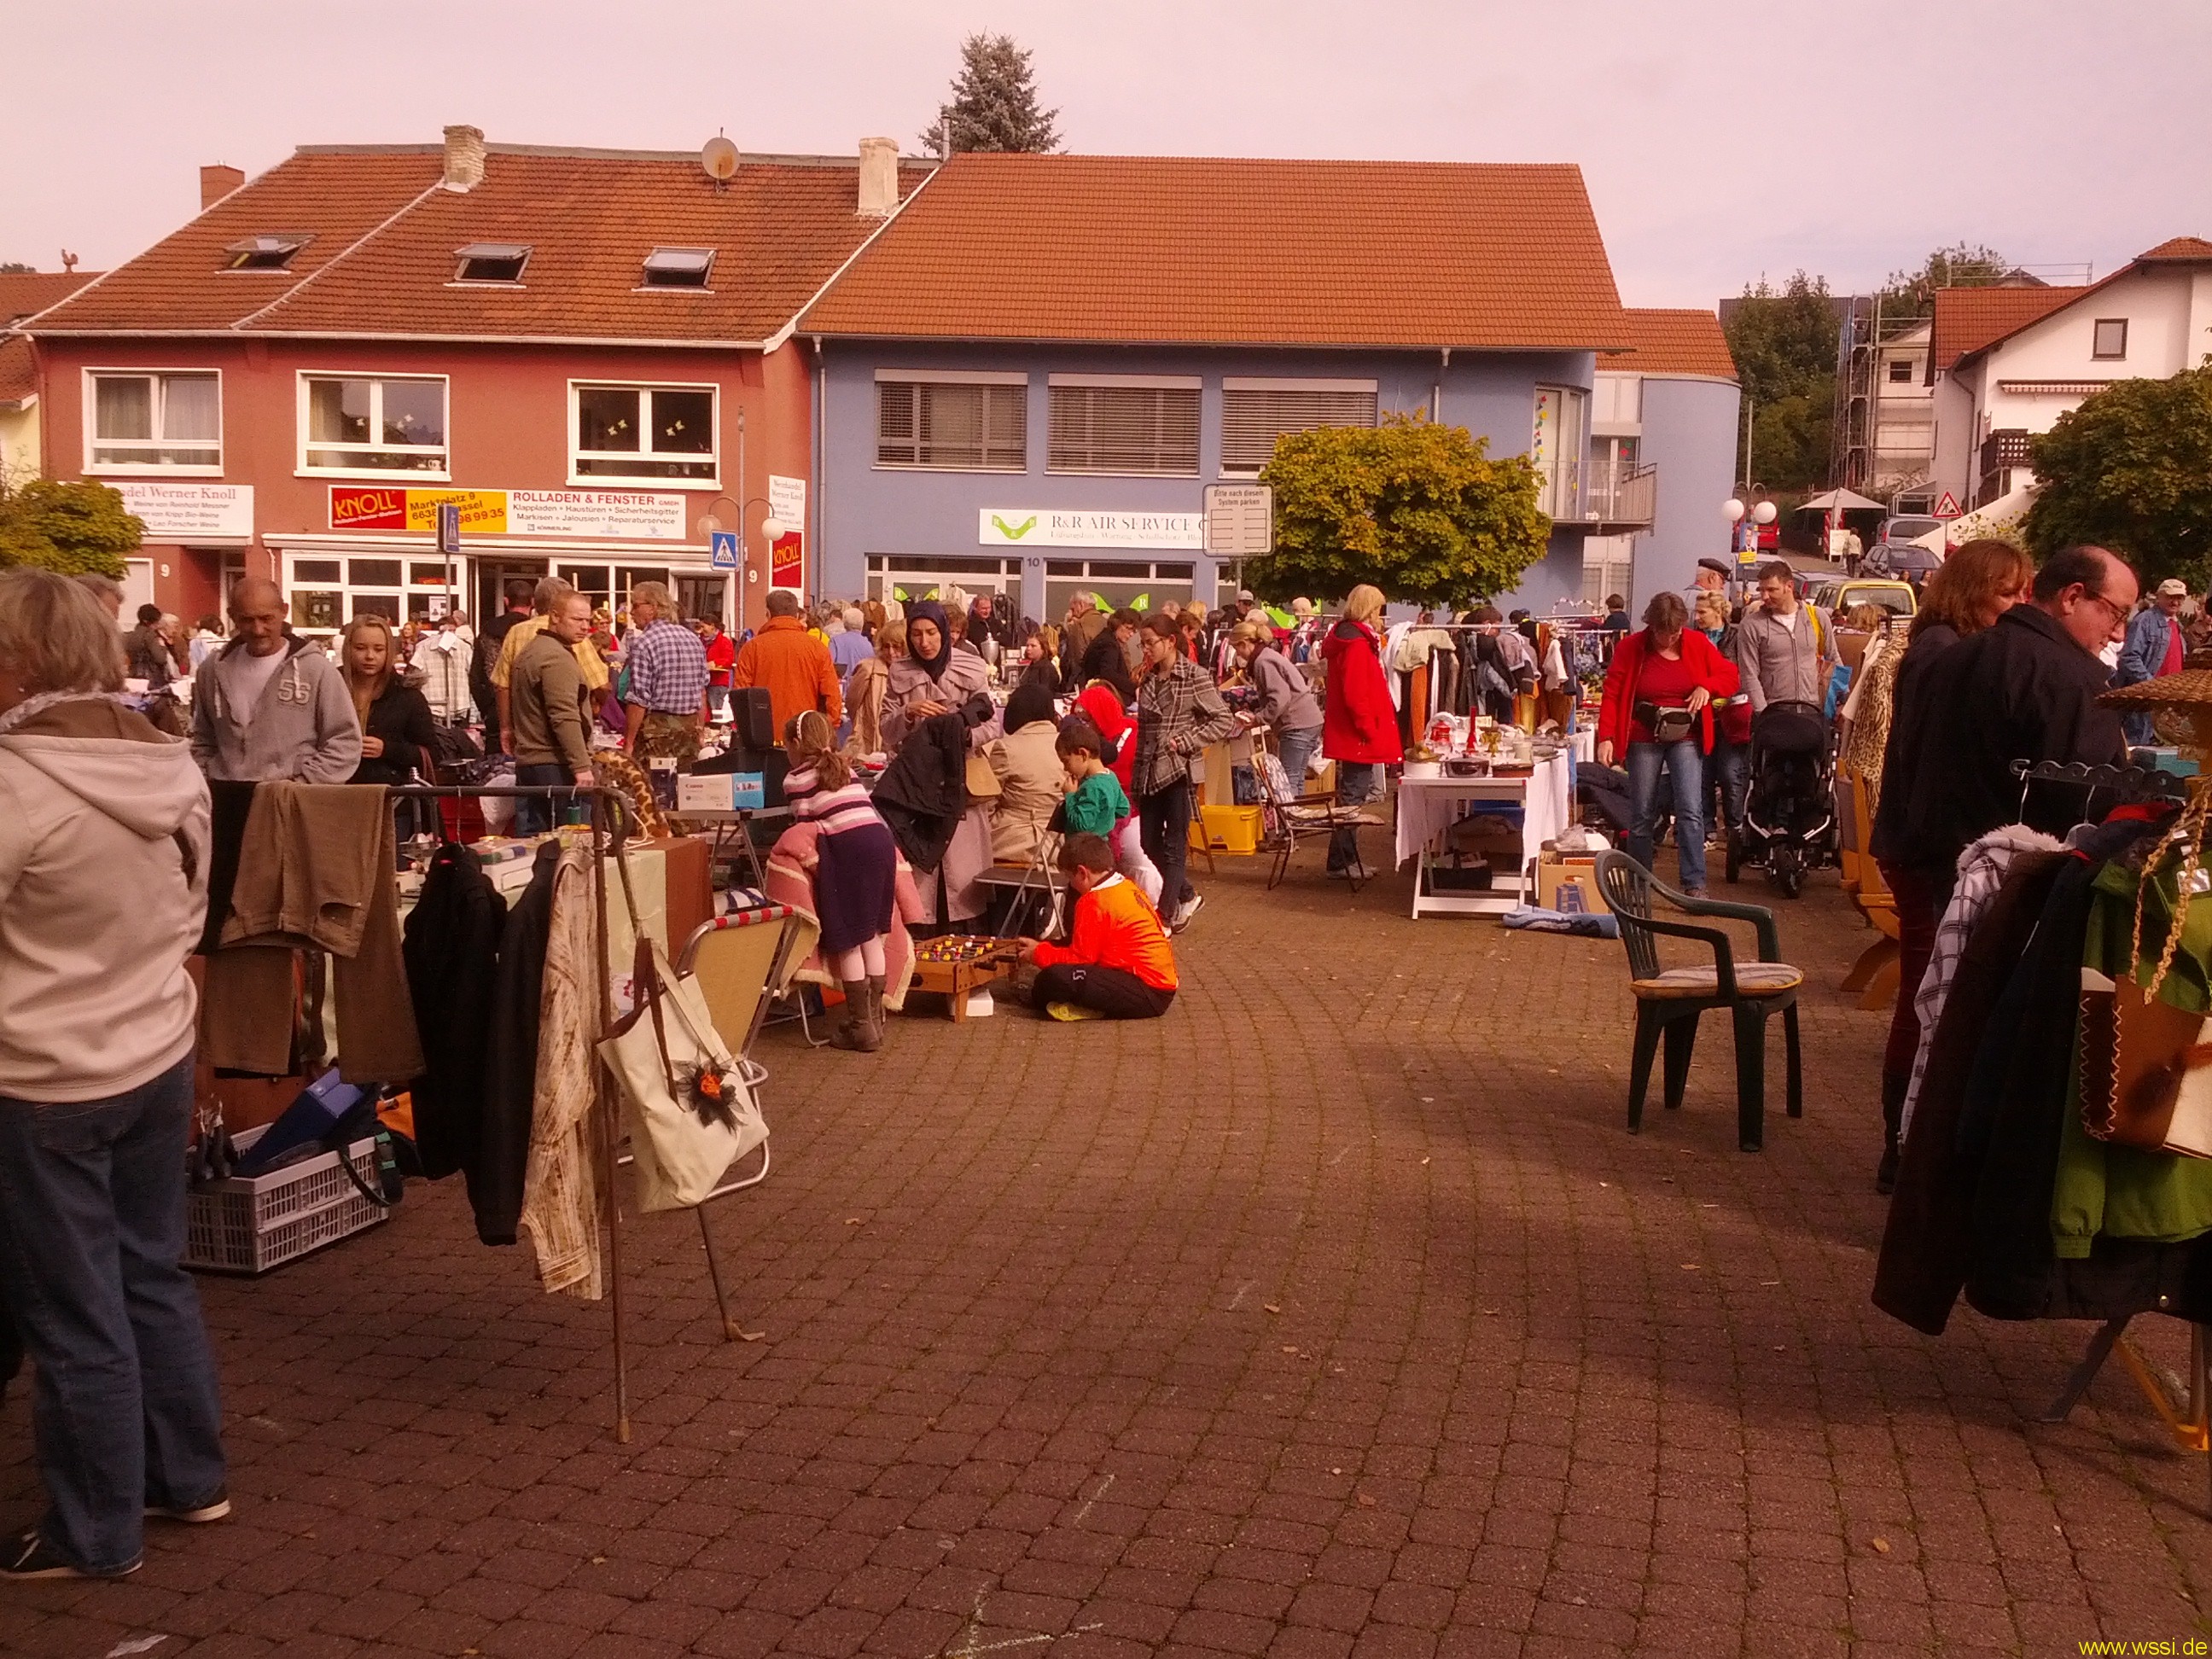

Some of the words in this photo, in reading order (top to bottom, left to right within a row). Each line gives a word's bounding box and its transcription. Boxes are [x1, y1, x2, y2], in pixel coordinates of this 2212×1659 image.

[149, 486, 197, 499] Werner
[201, 487, 236, 500] Knoll
[513, 492, 580, 503] ROLLADEN
[585, 494, 593, 504] &
[597, 494, 655, 505] FENSTER
[334, 491, 397, 518] KNOLL
[410, 494, 466, 510] Marktplatz
[469, 492, 475, 500] 9
[412, 508, 437, 520] 6638
[457, 500, 483, 511] ssel
[490, 508, 504, 518] 35
[513, 504, 557, 512] Klappladen
[614, 506, 679, 516] Sicherheitsgitter
[608, 515, 676, 525] Reparaturservice
[1052, 515, 1081, 528] R&R
[1088, 516, 1116, 530] AIR
[1122, 517, 1190, 531] SERVICE
[773, 543, 800, 566] KNOLL
[1027, 557, 1040, 568] 10
[160, 564, 170, 577] 9
[748, 569, 758, 583] 9
[1139, 598, 1147, 608] R
[278, 678, 311, 706] 56
